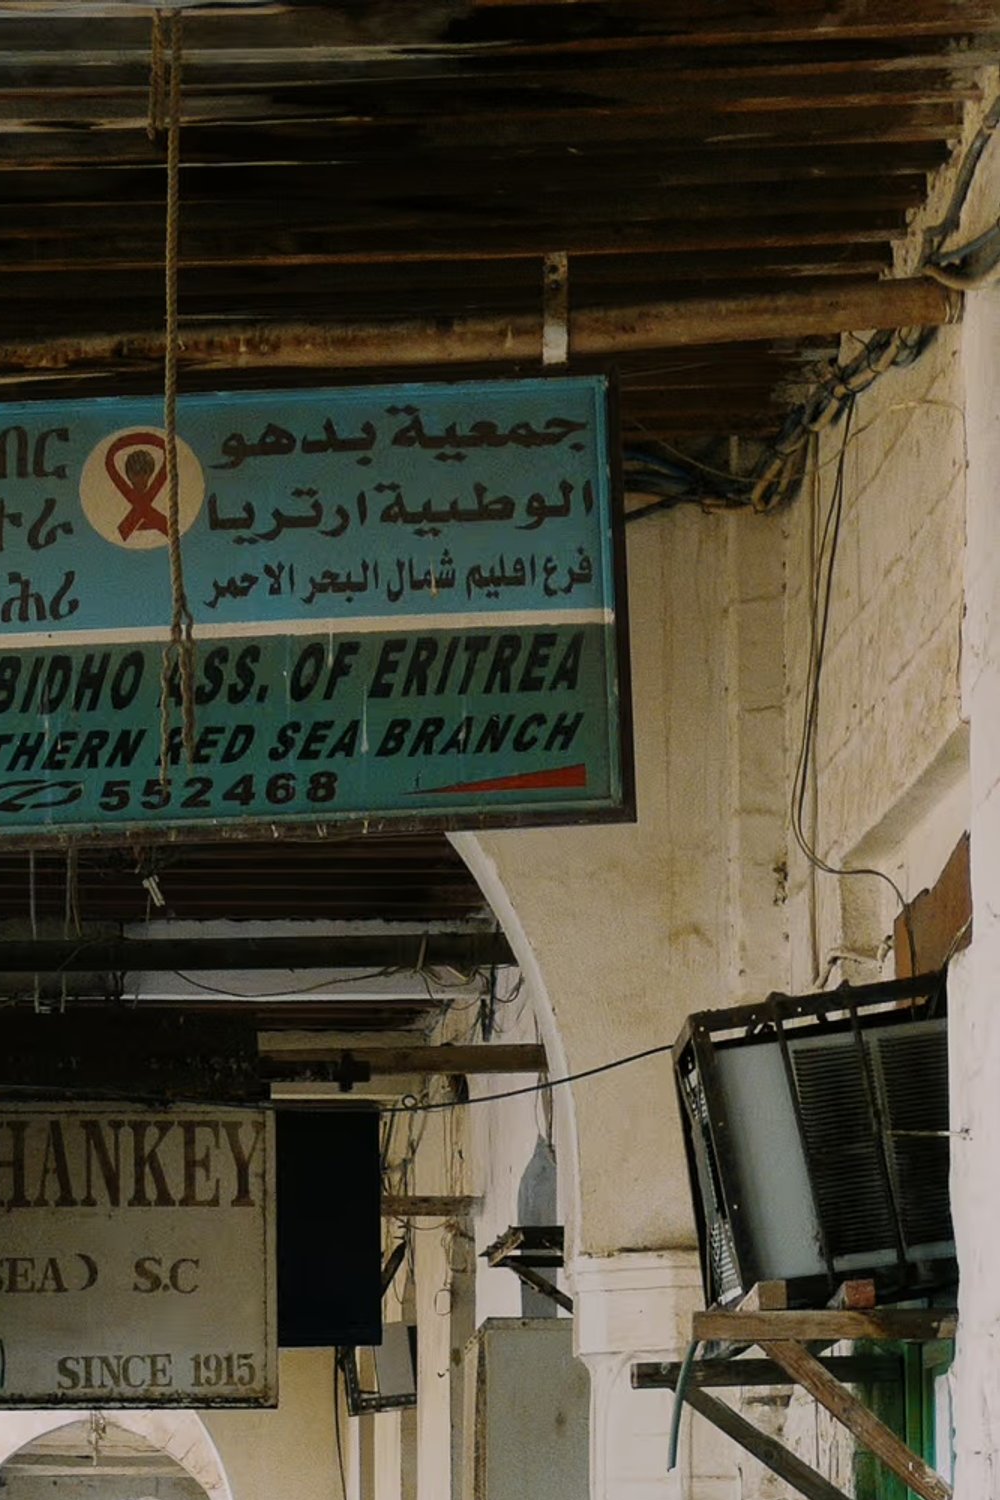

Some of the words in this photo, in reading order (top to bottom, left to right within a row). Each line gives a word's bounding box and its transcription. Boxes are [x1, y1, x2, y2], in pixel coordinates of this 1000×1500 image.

[209, 417, 377, 469] بدهو
[386, 405, 588, 462] جمعية
[300, 558, 380, 604] البحر
[387, 548, 456, 602] شمال
[543, 546, 593, 597] فرع
[289, 640, 360, 701] OF
[367, 632, 587, 699] ERITREA
[155, 724, 255, 767] RED
[269, 718, 363, 762] SEA
[375, 712, 585, 758] BRANCH
[99, 771, 338, 812] 552468
[57, 1353, 174, 1390] SINCE
[190, 1352, 255, 1388] 1915
